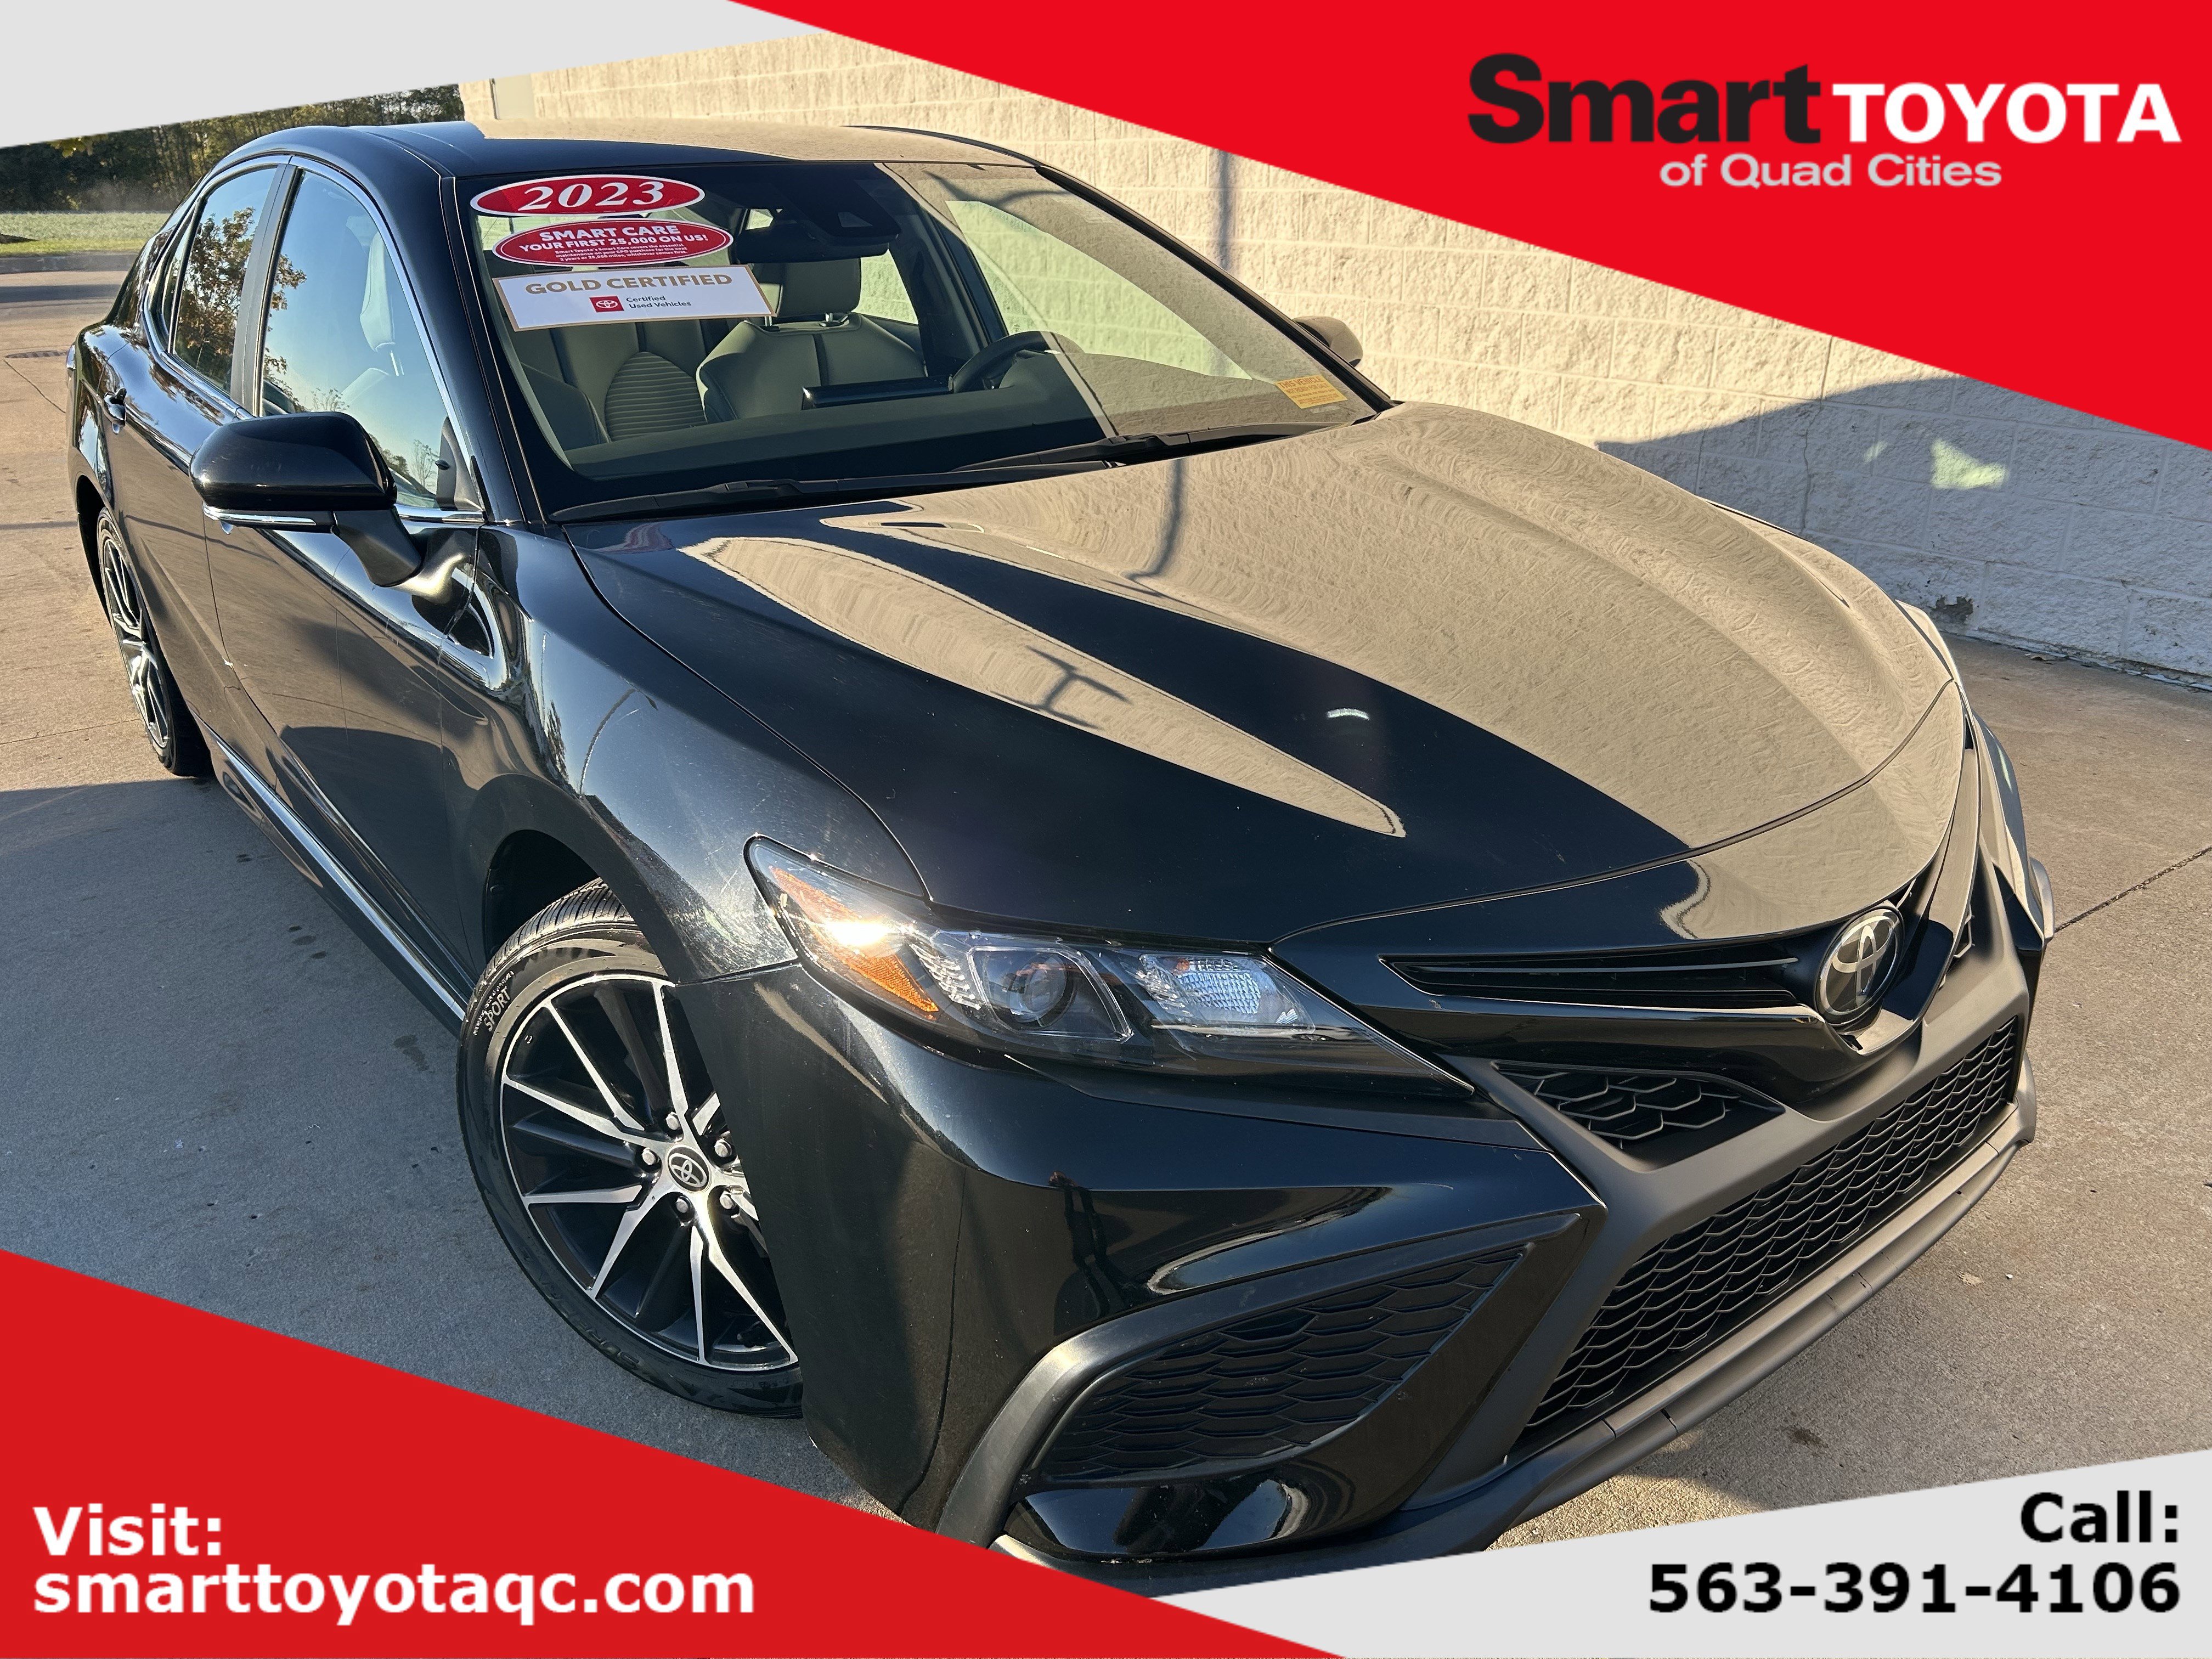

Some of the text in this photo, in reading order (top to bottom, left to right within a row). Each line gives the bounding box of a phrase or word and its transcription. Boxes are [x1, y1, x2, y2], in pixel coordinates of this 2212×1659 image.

[517, 181, 665, 211] 2023
[539, 225, 681, 241] SMART CARE
[519, 242, 565, 252] YOUR
[608, 237, 657, 245] 25,000
[525, 274, 732, 295] GOLD CERTIFIED
[484, 985, 510, 1032] SPORT
